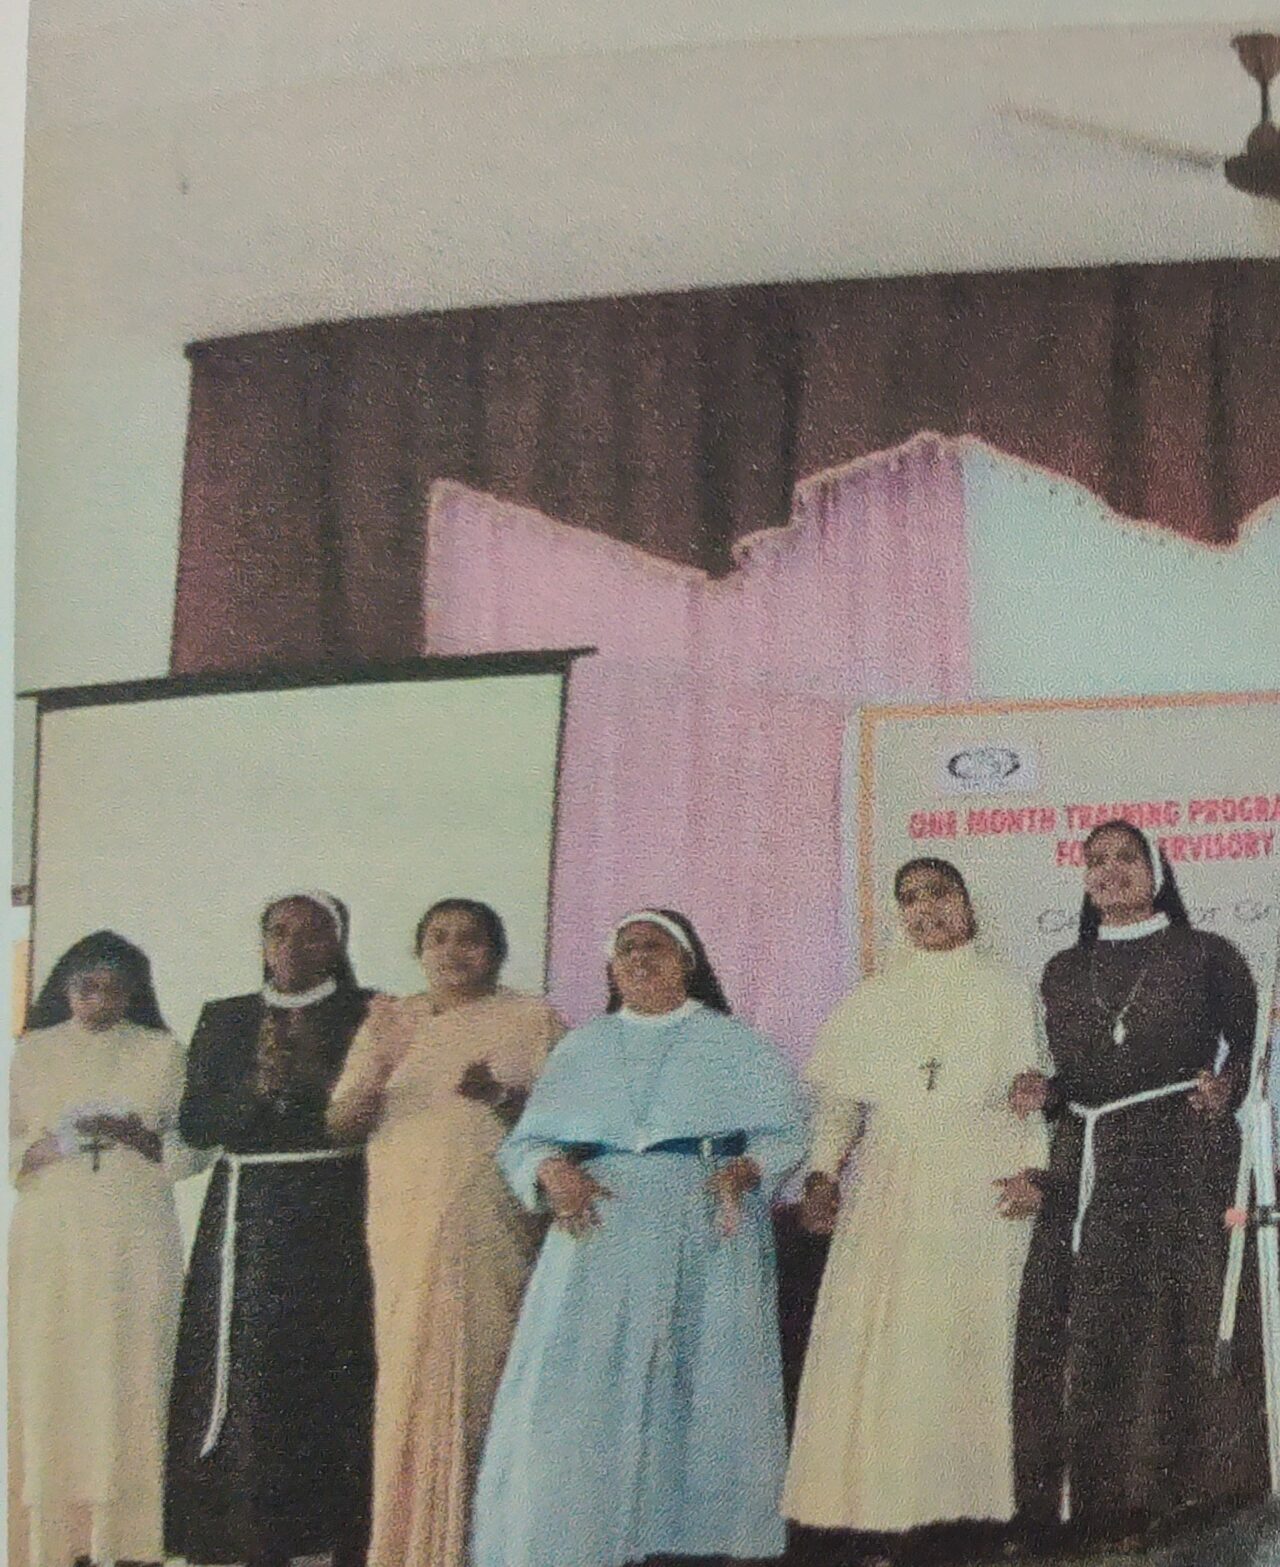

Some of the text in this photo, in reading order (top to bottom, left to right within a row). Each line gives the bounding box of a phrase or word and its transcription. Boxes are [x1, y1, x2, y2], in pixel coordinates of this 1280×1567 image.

[909, 810, 958, 838] ONE
[965, 807, 1057, 835] MONTH
[1066, 801, 1181, 829] TRAINING
